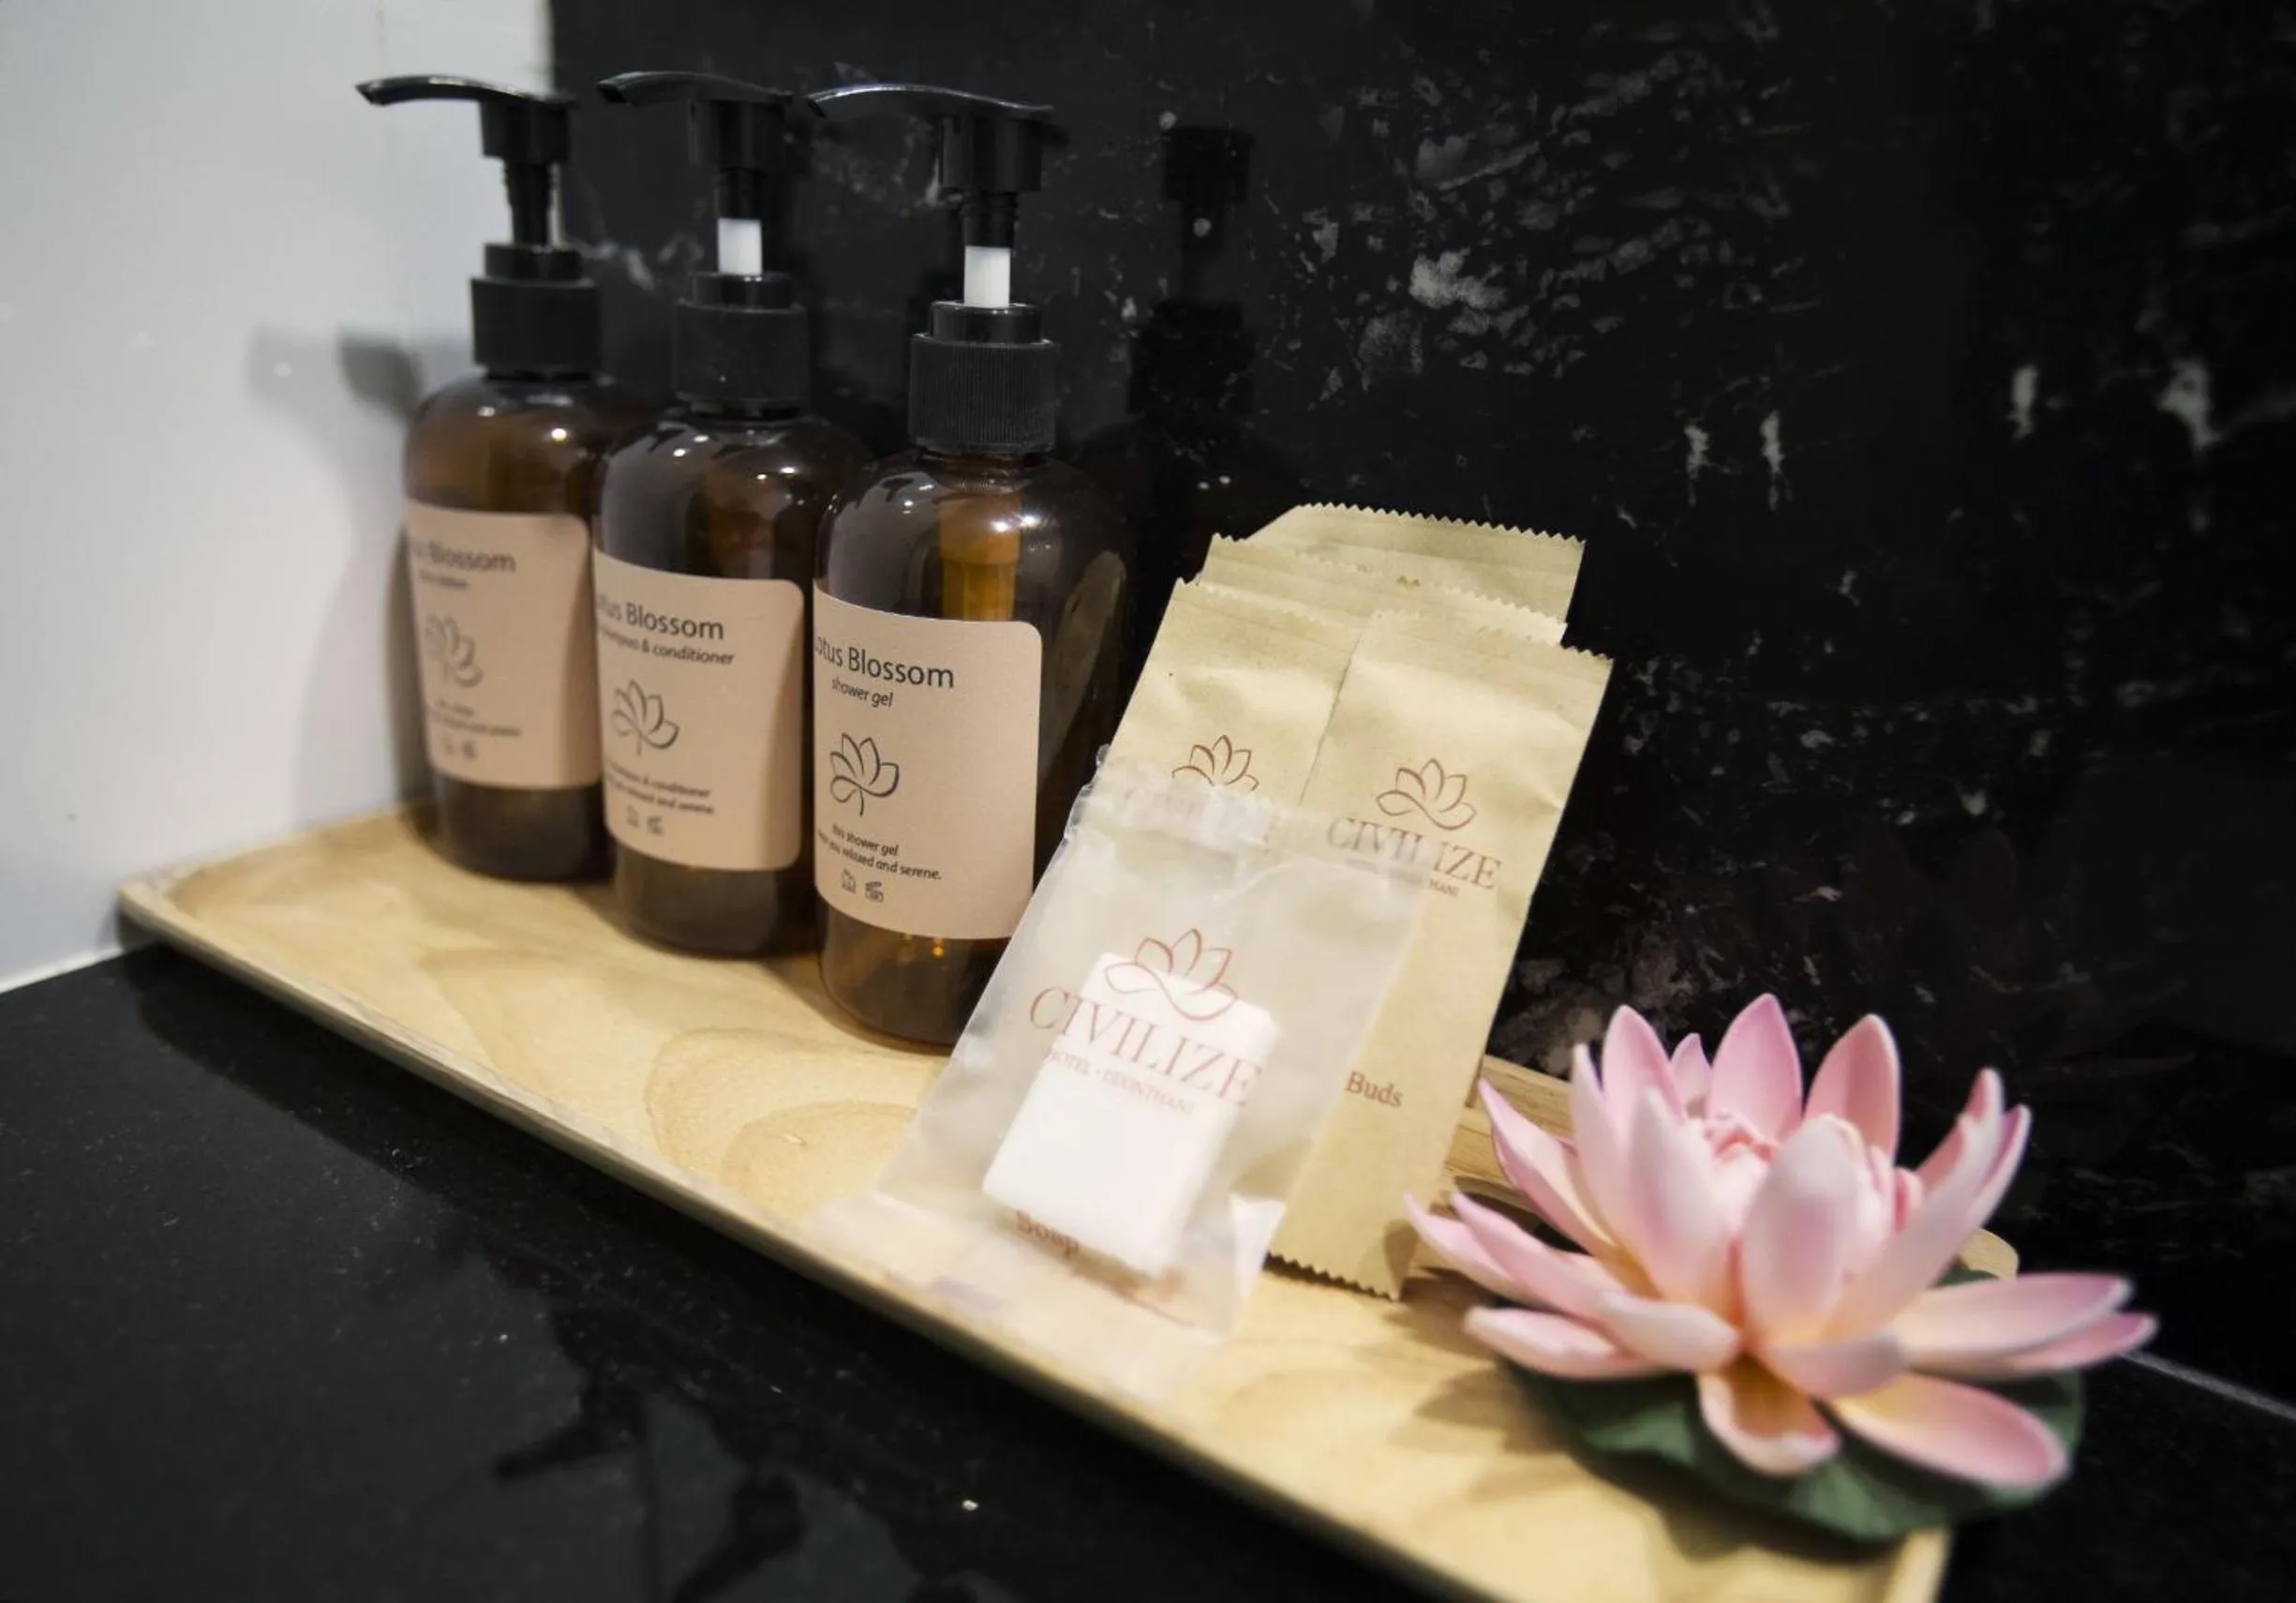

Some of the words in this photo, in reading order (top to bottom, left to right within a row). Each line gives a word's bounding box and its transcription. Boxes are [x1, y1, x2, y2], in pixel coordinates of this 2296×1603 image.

[626, 602, 723, 640] Blossom
[652, 643, 735, 665] conditioner
[848, 647, 954, 688] Blossom
[832, 675, 870, 702] shower
[872, 691, 893, 709] gel
[846, 831, 879, 851] shower
[881, 844, 900, 857] gel
[1326, 815, 1503, 891] CIVILIZE
[875, 861, 898, 874] and
[1029, 986, 1263, 1107] CIVILIZE
[1344, 1071, 1404, 1107] Buds
